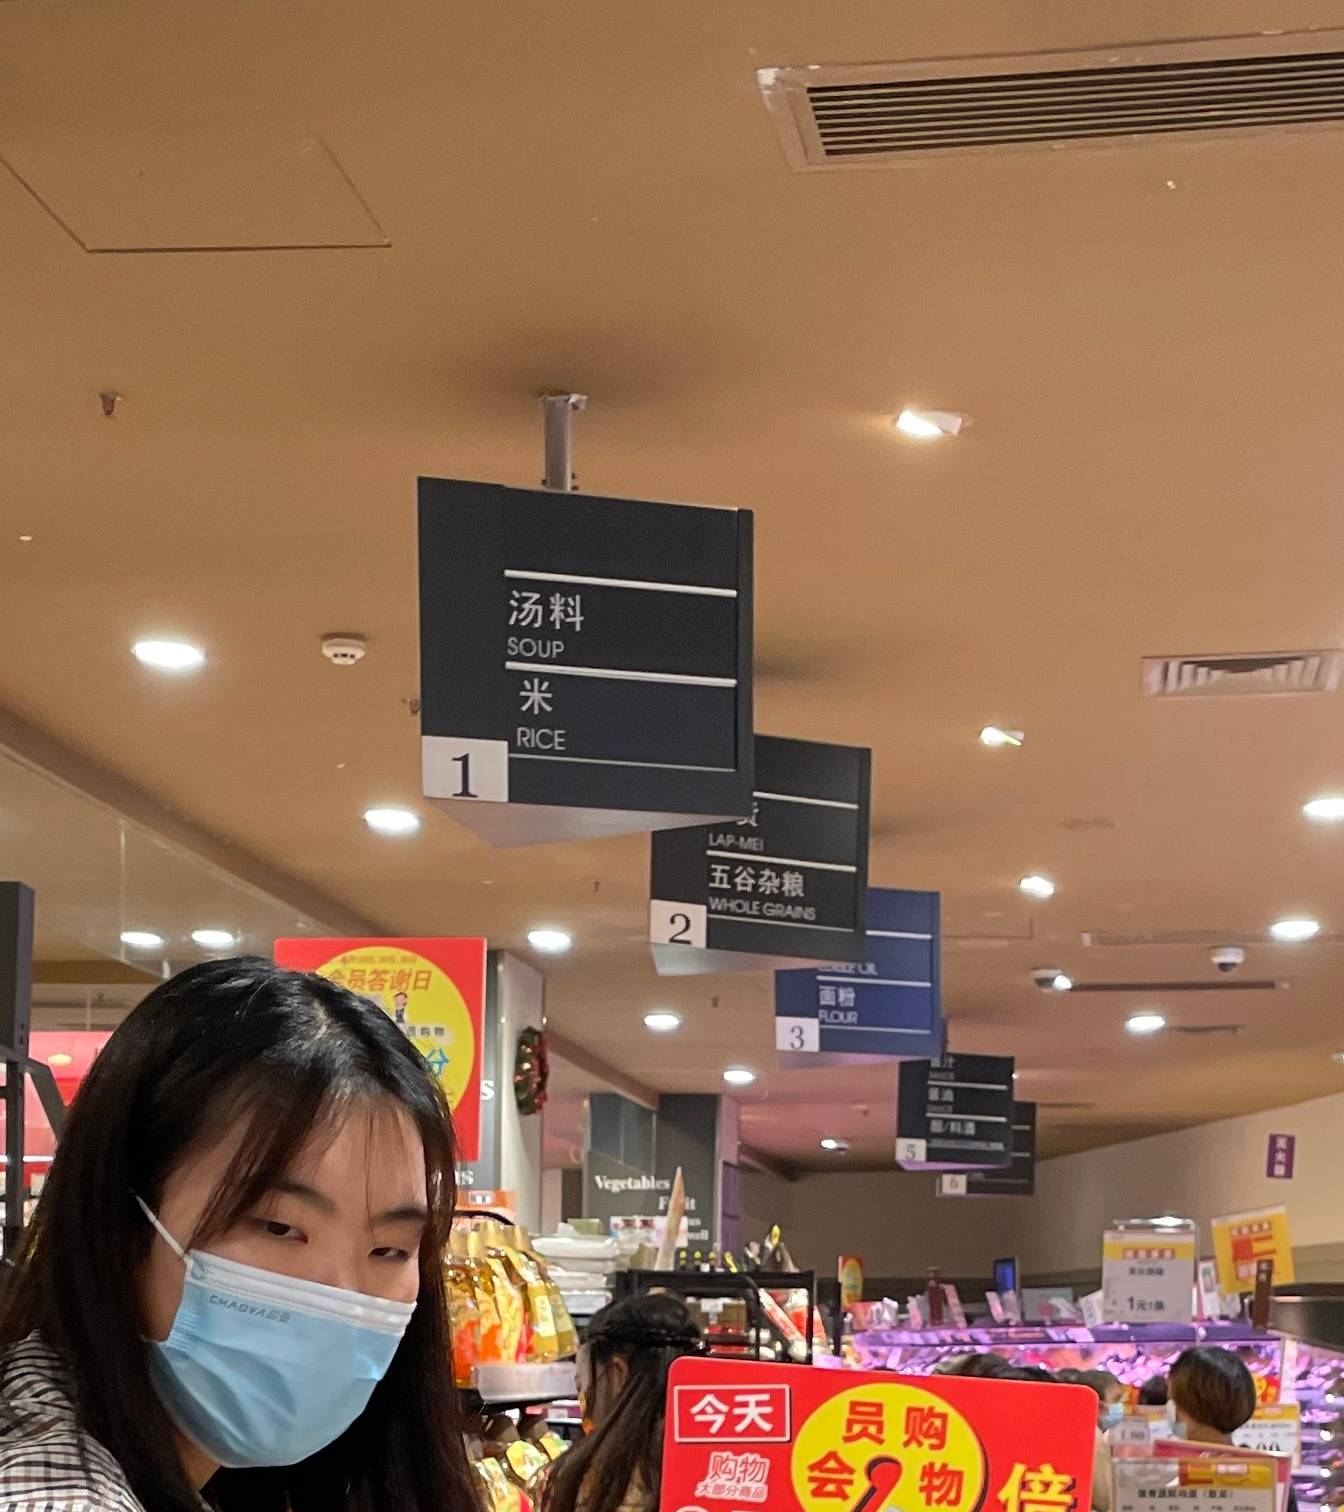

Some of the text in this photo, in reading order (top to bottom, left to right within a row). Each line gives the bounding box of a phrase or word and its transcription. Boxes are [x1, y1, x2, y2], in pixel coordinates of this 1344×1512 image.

[506, 589, 585, 633] 汤料
[506, 636, 566, 659] SOUP
[518, 678, 554, 715] 米
[516, 727, 567, 752] RICE
[452, 753, 479, 798] 1
[709, 863, 805, 897] 五谷杂粮
[709, 897, 816, 921] WHOLE GRAINS
[668, 912, 692, 945] 2
[790, 1025, 805, 1049] 3
[593, 1175, 670, 1193] Vegetables
[689, 1394, 775, 1435] 今天
[709, 1451, 770, 1484] 购物
